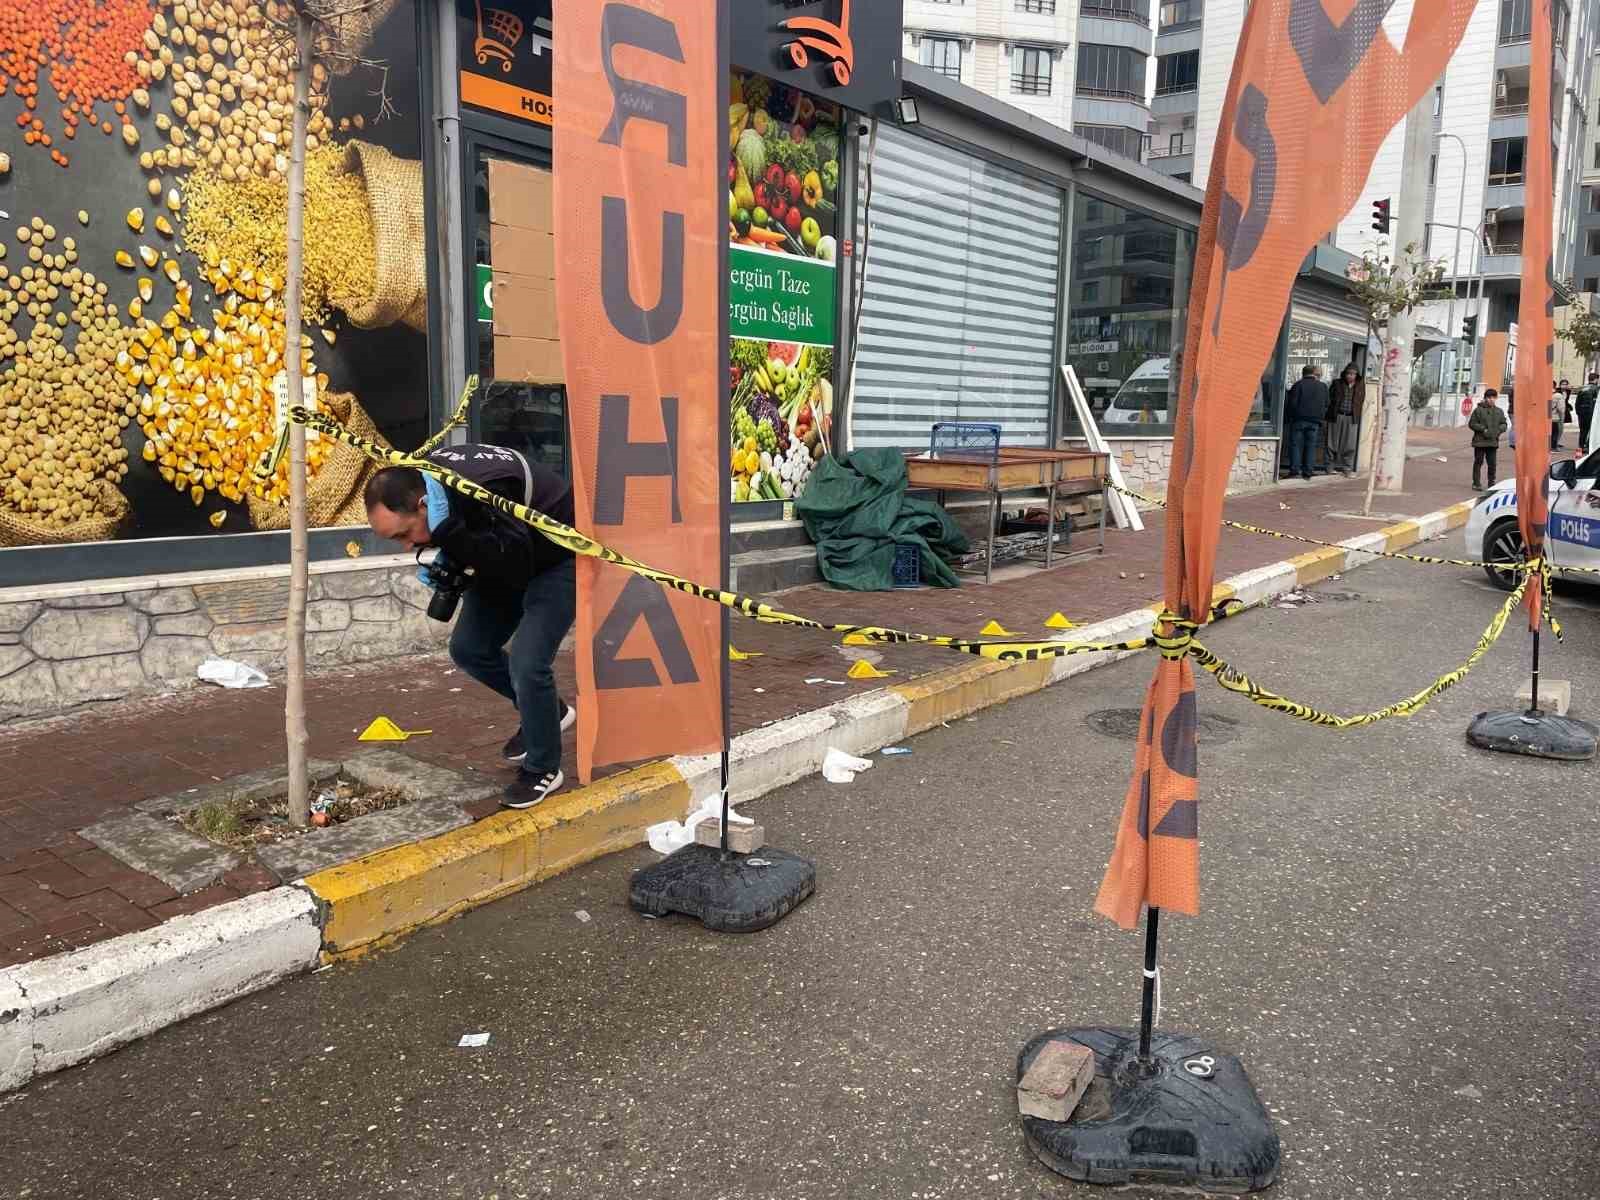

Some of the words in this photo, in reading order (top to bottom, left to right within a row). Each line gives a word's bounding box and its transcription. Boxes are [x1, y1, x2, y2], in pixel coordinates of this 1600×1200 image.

[730, 268, 772, 292] ergün
[777, 269, 811, 295] Taze
[729, 301, 767, 325] rgün
[771, 301, 814, 330] Sağlık
[1560, 518, 1590, 543] POLİS
